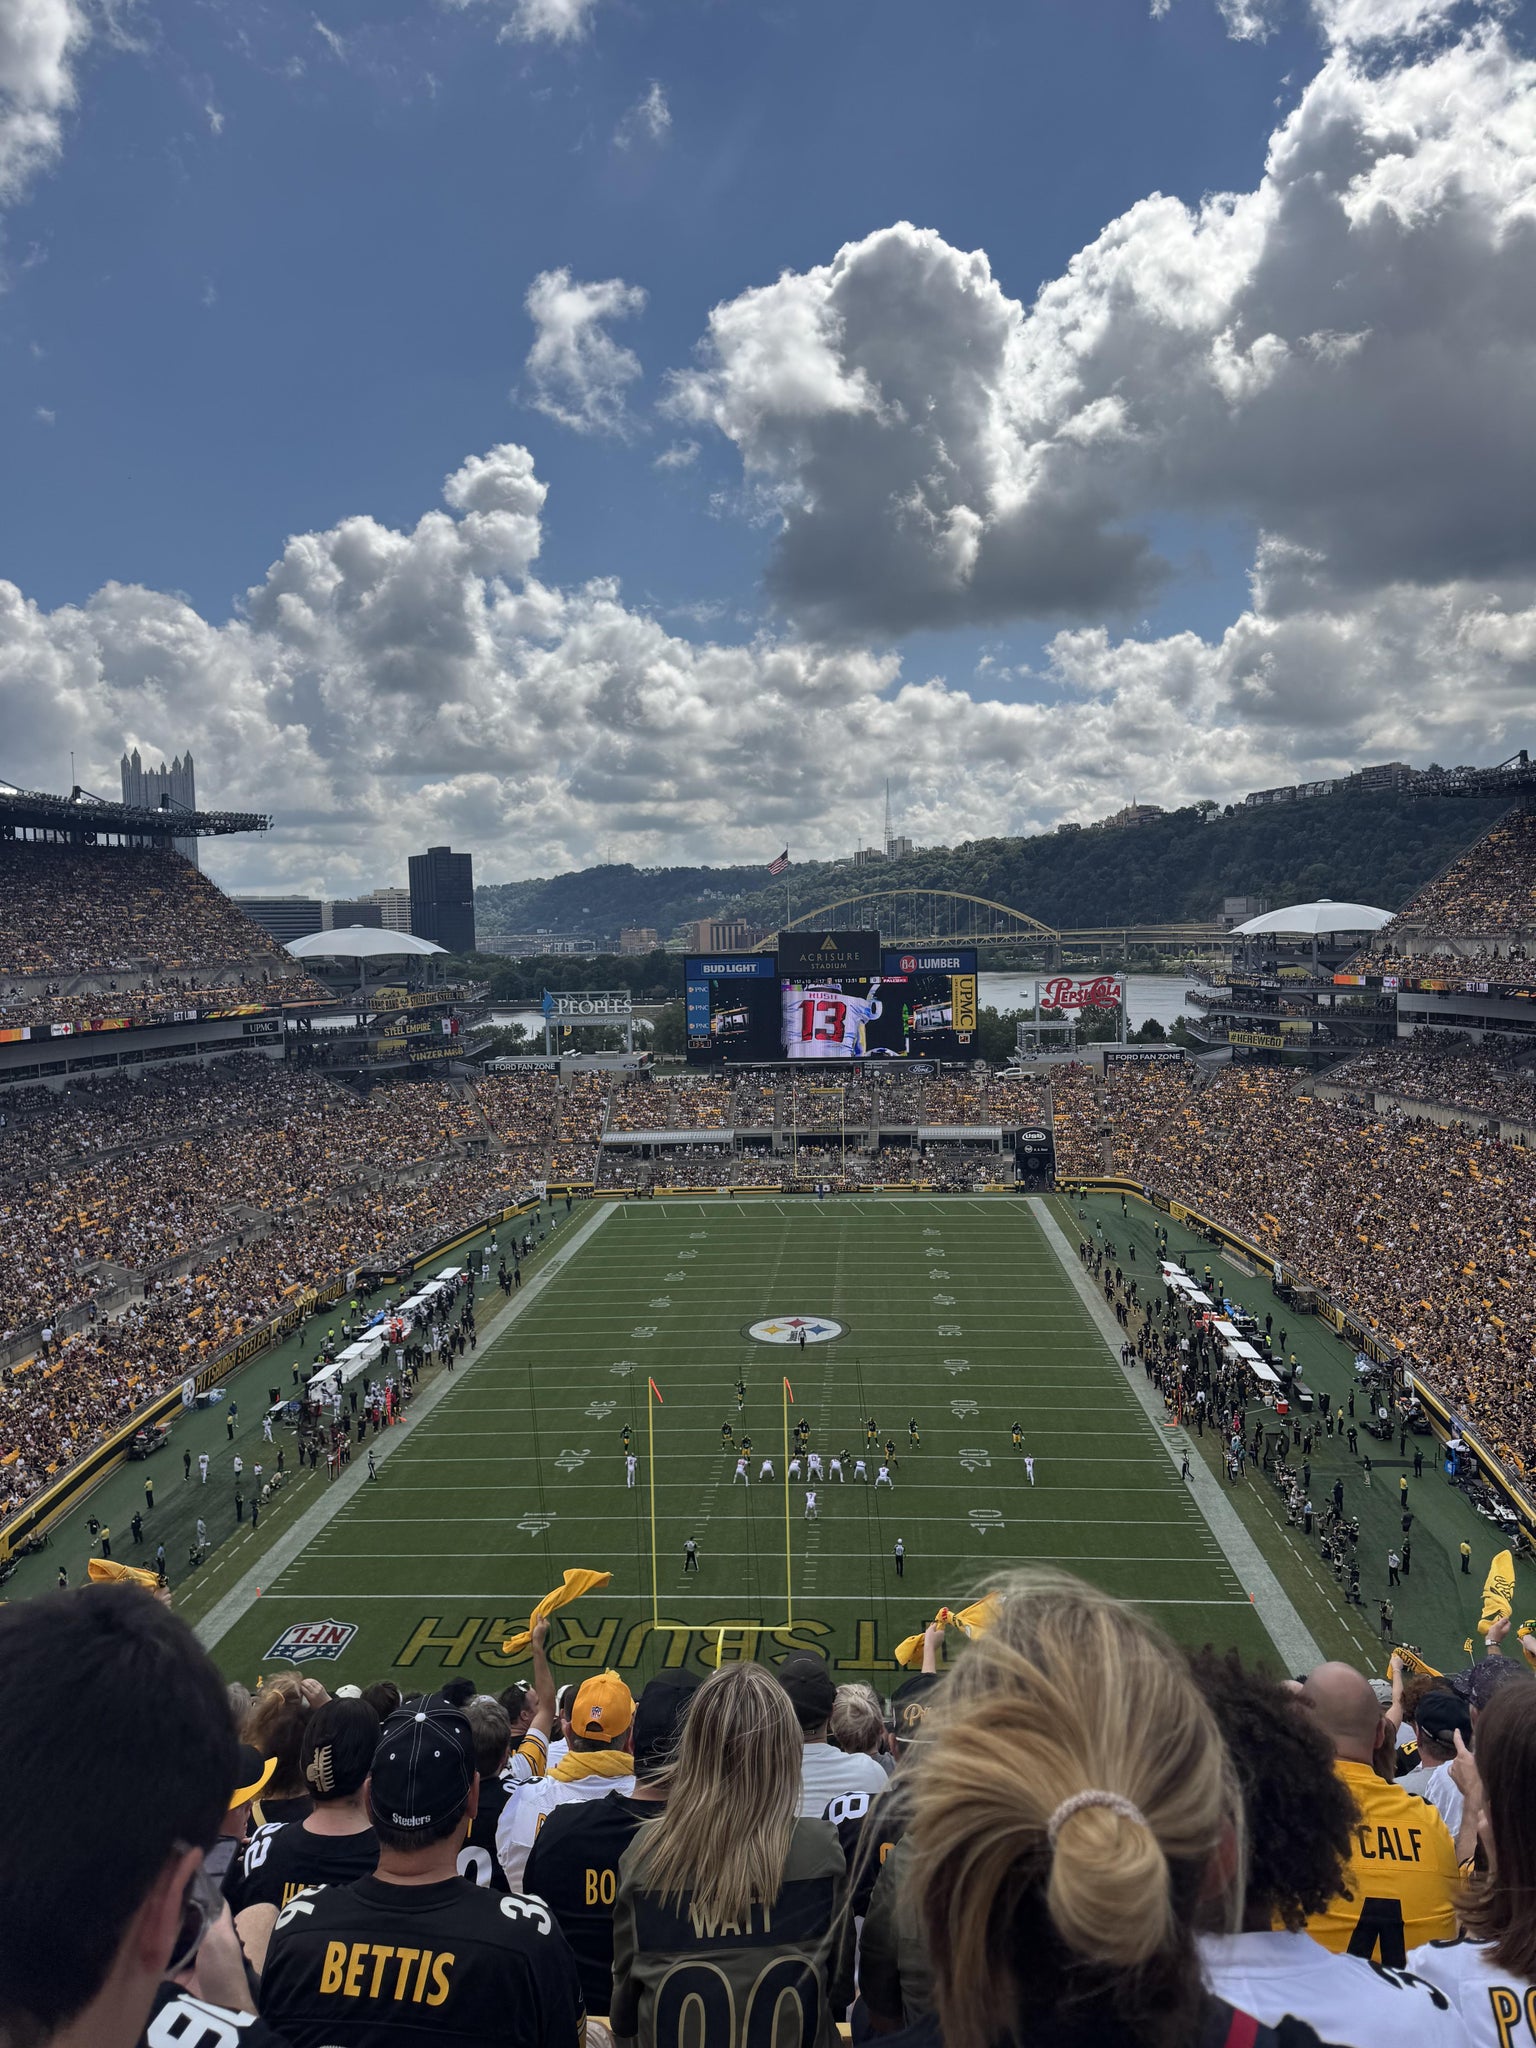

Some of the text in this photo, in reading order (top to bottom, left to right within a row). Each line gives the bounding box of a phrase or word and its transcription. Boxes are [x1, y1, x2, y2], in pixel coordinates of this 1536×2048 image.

[799, 952, 860, 961] ACRISURE
[918, 958, 960, 969] LUMBER
[703, 964, 757, 973] BUD LIGHT
[558, 998, 632, 1015] PEOPLES
[960, 977, 974, 1027] UPMC
[250, 1023, 274, 1033] UPMC
[798, 1000, 847, 1043] 13
[384, 1022, 431, 1037] STEEL EMPIRE
[1230, 1032, 1282, 1047] #HEREWEGO
[410, 1049, 444, 1061] YINZER
[1115, 1053, 1181, 1061] FORD FAN ZONE
[495, 1063, 516, 1071] FORD
[516, 1063, 533, 1071] FAN
[238, 1326, 270, 1361] STEELERS
[516, 1511, 557, 1531] 10
[968, 1509, 1005, 1529] 10
[290, 1625, 350, 1645] NFL
[392, 1811, 432, 1827] Steelers
[319, 1940, 456, 2007] BETTIS
